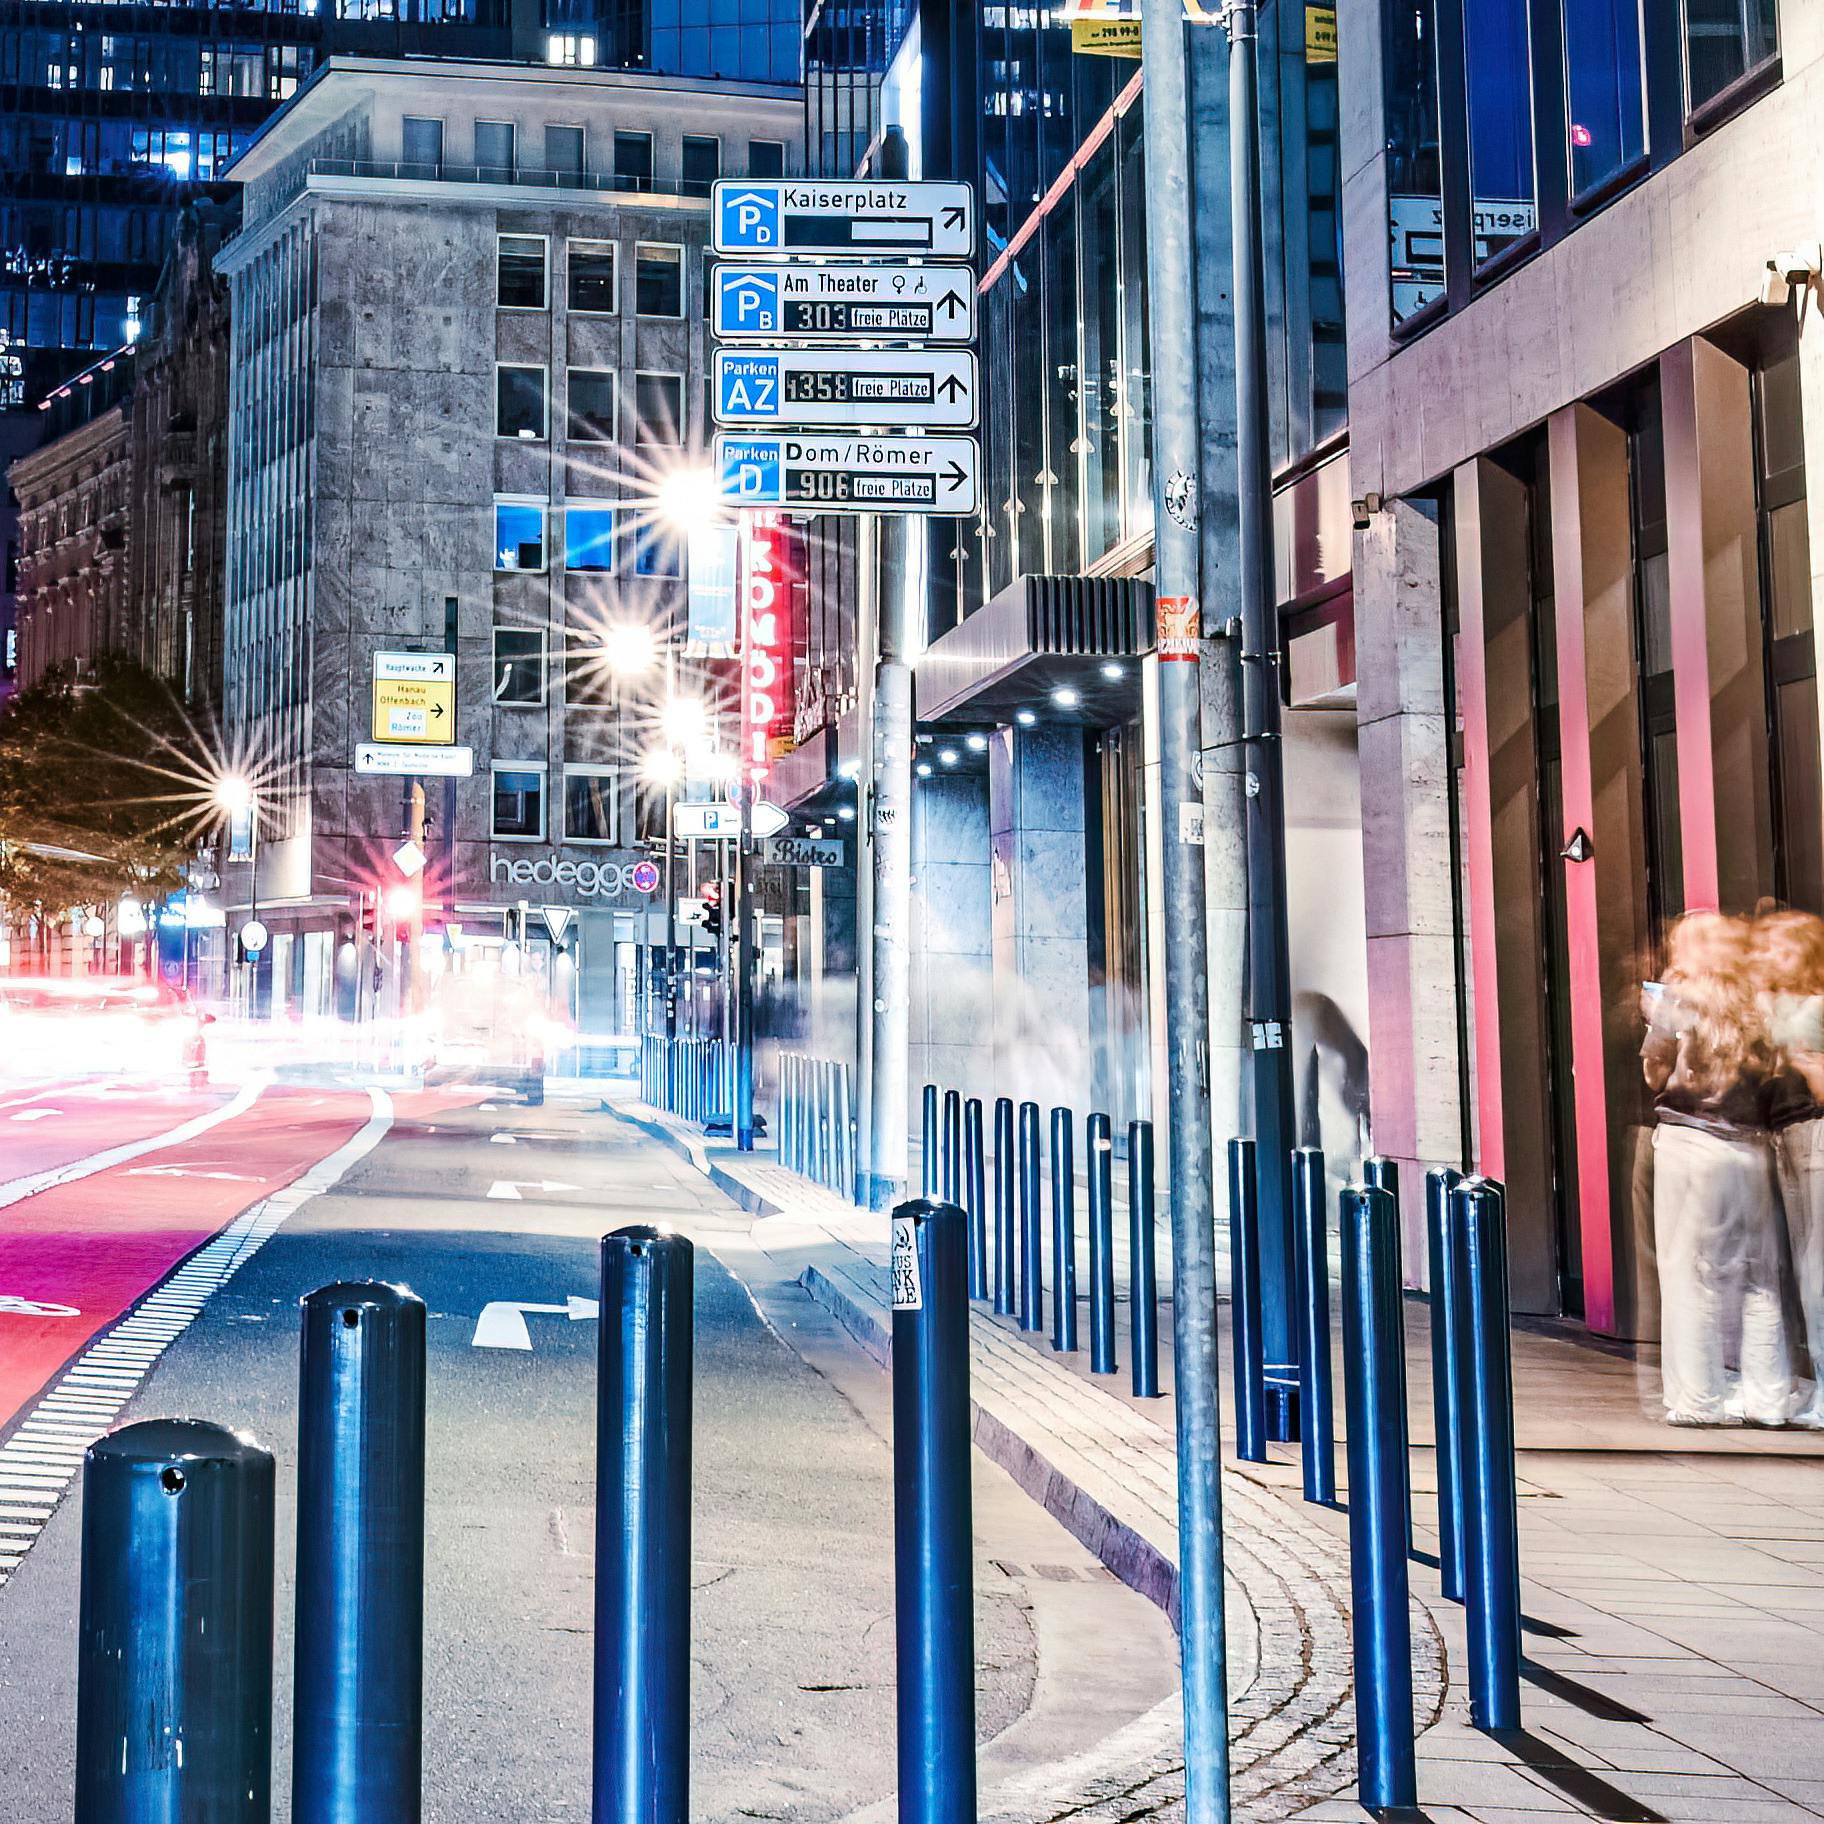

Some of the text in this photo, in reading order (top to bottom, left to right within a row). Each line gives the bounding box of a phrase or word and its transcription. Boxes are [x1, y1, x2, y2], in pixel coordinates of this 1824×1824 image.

[784, 189, 907, 212] Kaiserplatz
[784, 274, 878, 293] Am Theater
[798, 303, 927, 330] 303 freie Plätze
[723, 360, 777, 376] Parken
[726, 379, 775, 412] AZ
[787, 372, 928, 401] 1358 freie Plätze
[725, 445, 777, 462] Parken
[739, 464, 762, 497] D
[857, 479, 885, 497] freie
[892, 479, 930, 498] Plätze
[380, 696, 426, 706] Offenbach
